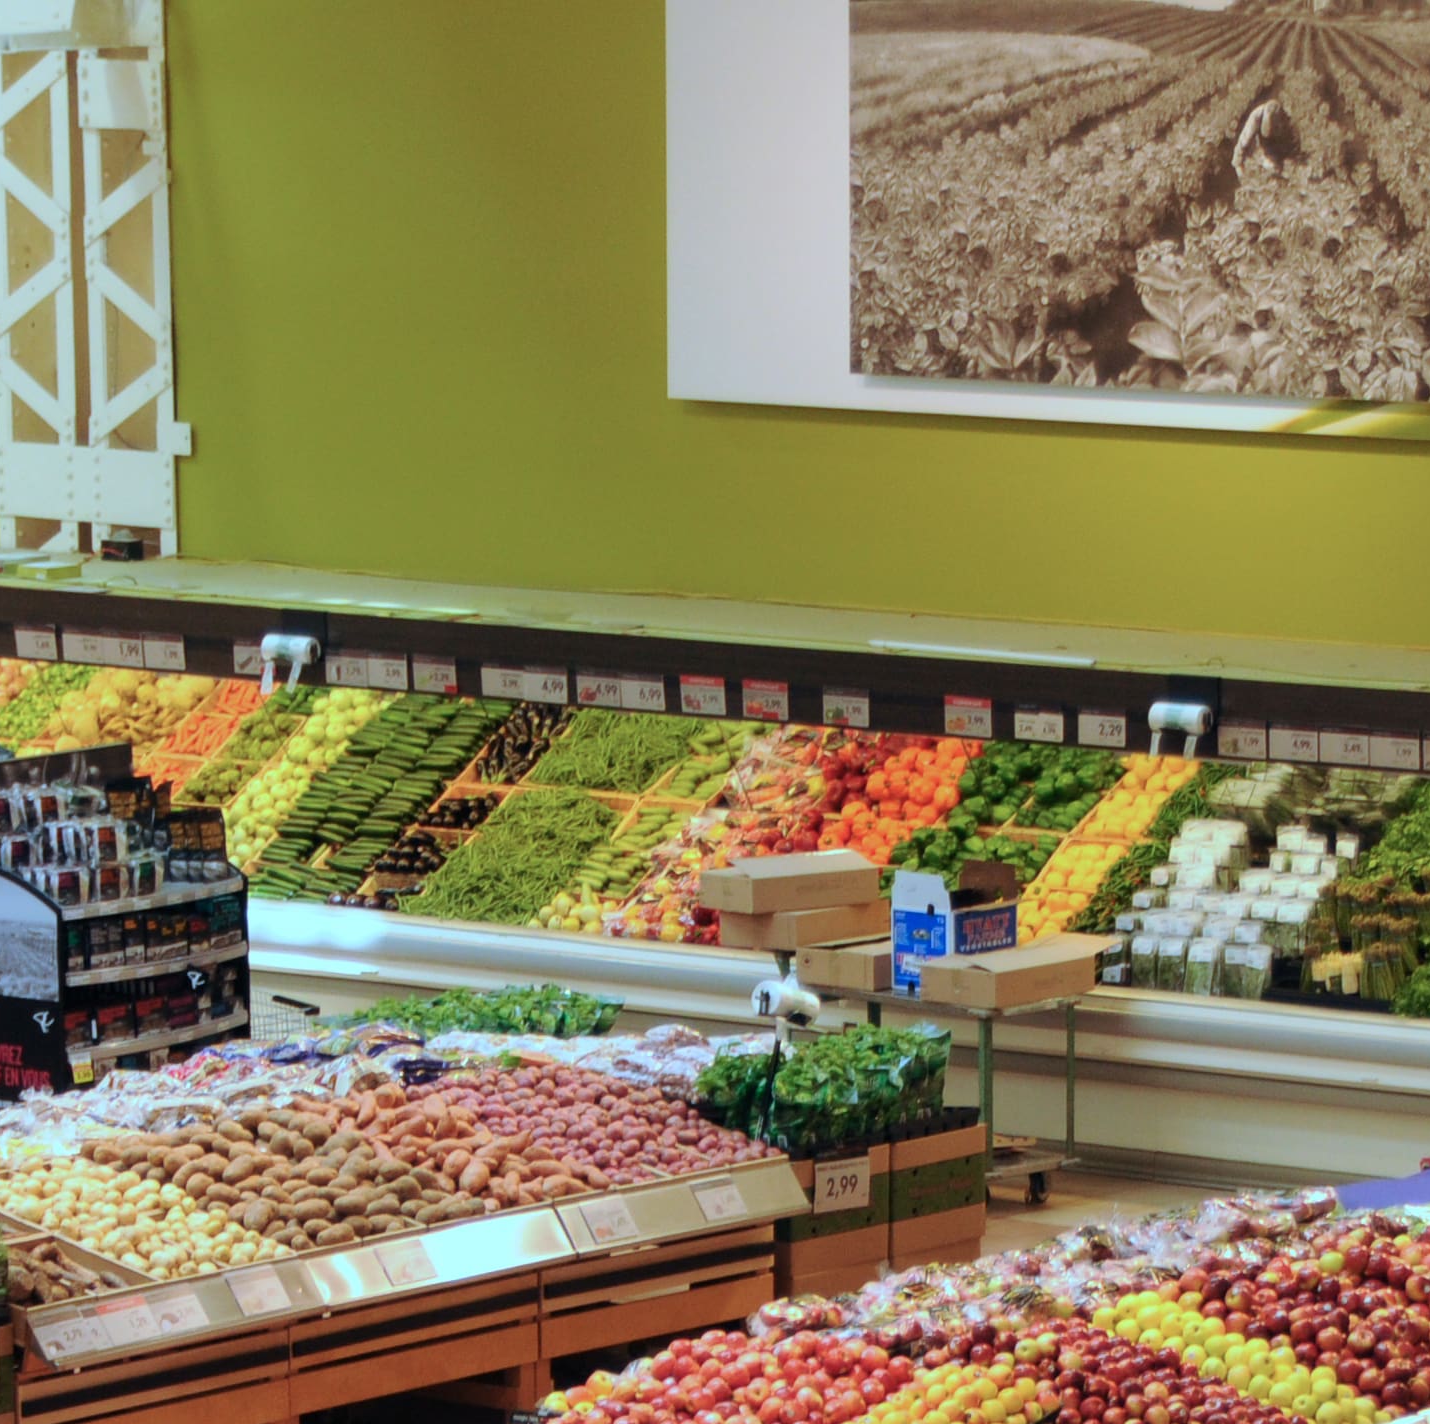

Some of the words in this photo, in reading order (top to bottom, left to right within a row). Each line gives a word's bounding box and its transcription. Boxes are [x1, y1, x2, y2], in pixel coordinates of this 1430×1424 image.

[119, 641, 140, 658] 1,99
[542, 680, 564, 694] 4,99
[596, 683, 619, 698] 4,99
[639, 688, 662, 703] 6,99
[1099, 721, 1122, 737] 2,29
[1243, 738, 1260, 748] 1,99
[5, 1066, 20, 1087] EN
[826, 1174, 858, 1199] 2,99
